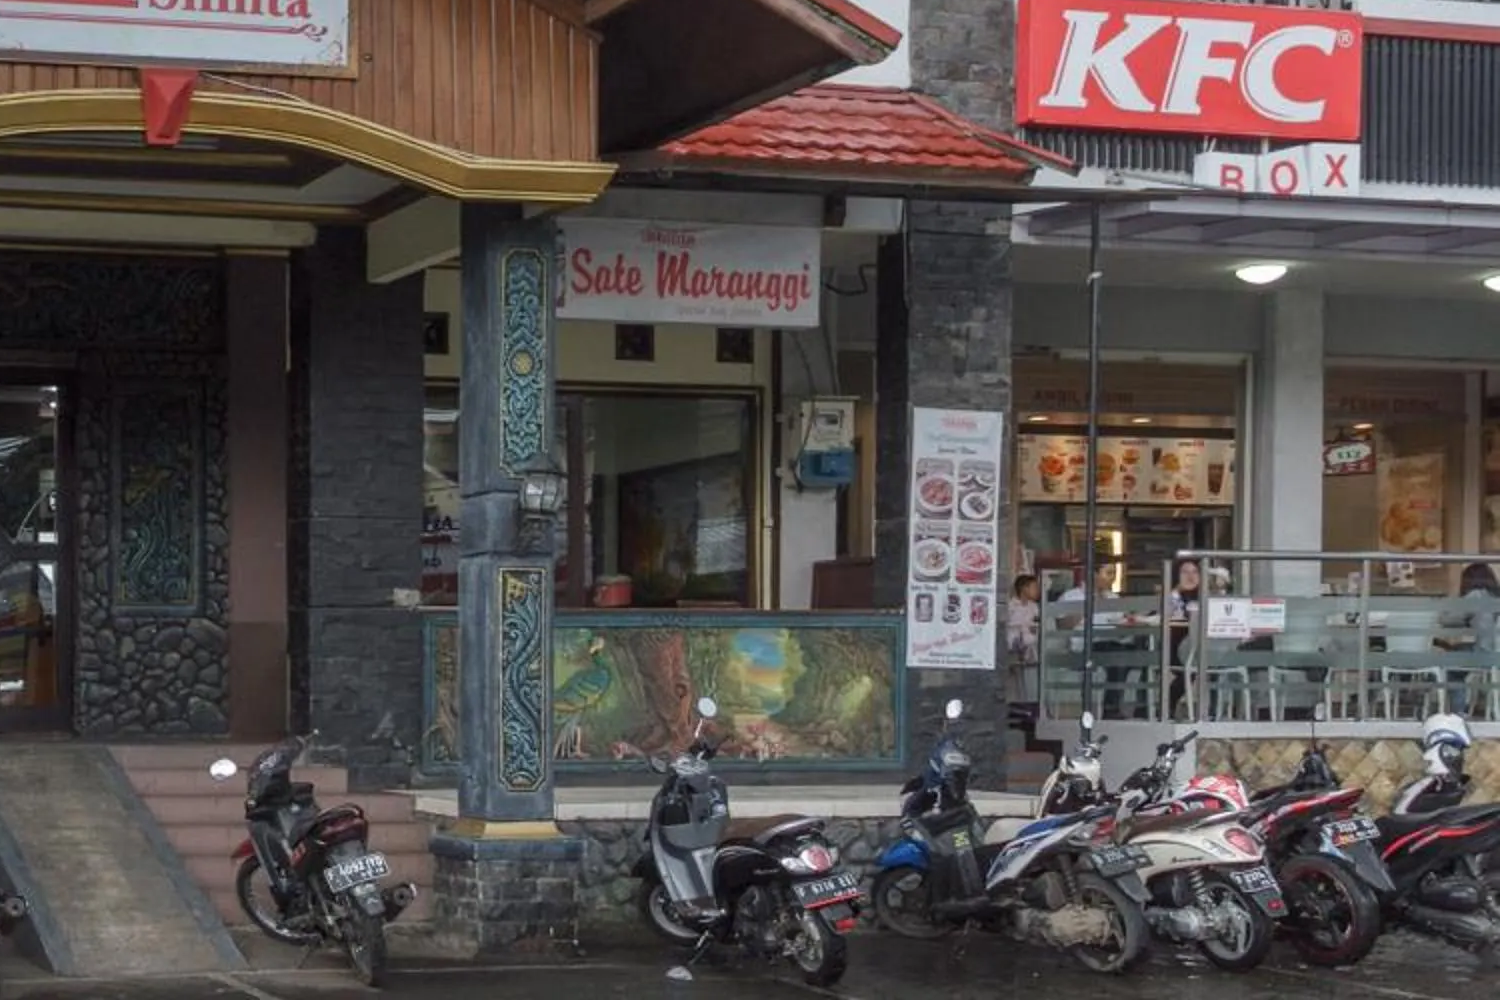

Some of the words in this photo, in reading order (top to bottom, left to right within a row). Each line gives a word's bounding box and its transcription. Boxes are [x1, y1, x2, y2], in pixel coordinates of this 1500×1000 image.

[1039, 9, 1338, 122] KFC
[570, 247, 644, 297] Sate
[656, 250, 812, 311] Maranggi
